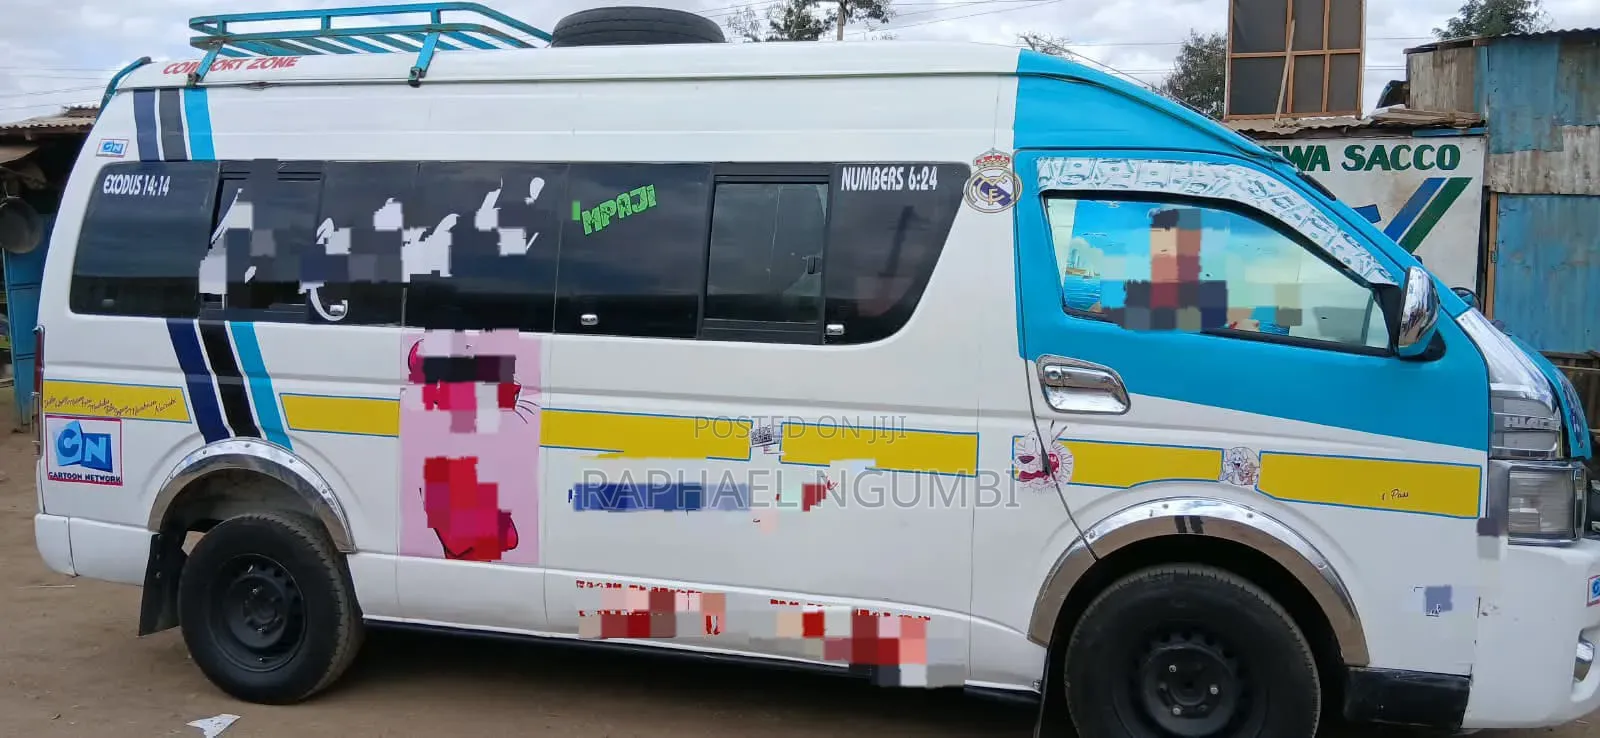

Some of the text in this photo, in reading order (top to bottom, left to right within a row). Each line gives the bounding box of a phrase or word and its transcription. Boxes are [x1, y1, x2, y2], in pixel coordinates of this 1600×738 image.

[163, 56, 301, 75] COMORT ZONE
[1341, 144, 1461, 171] SACCO
[103, 174, 171, 196] EXODUS 14:14
[841, 166, 938, 191] NUMBERS 6:24
[56, 426, 109, 466] CN
[48, 471, 121, 483] CARTOON NETWORK
